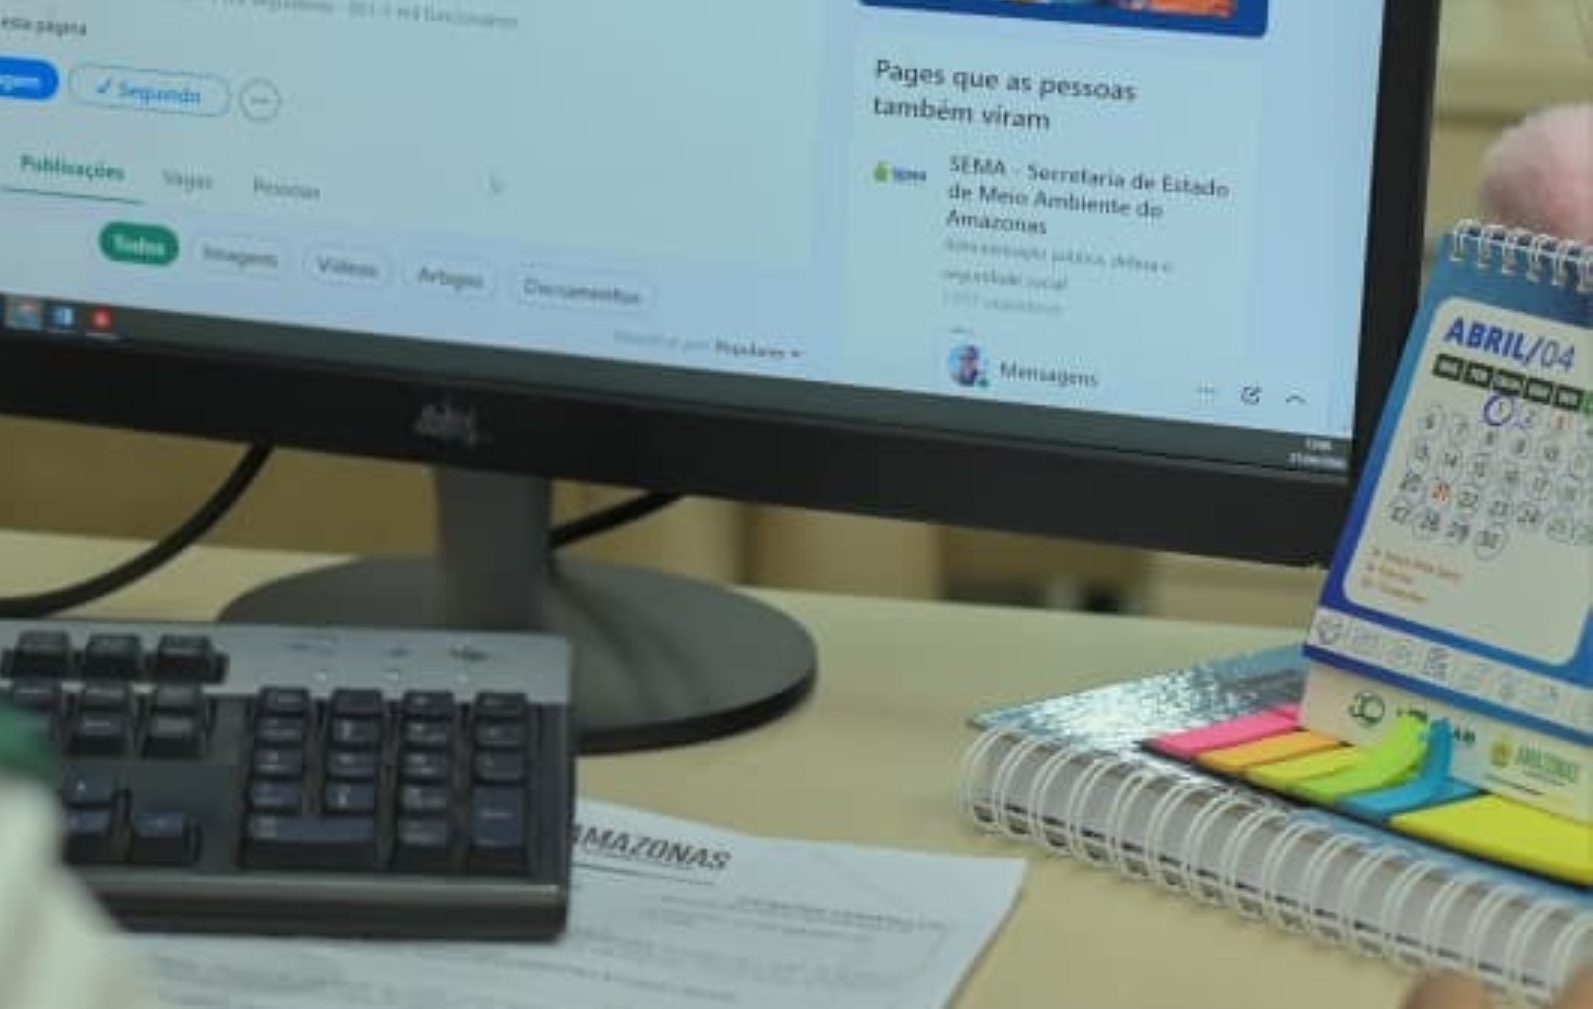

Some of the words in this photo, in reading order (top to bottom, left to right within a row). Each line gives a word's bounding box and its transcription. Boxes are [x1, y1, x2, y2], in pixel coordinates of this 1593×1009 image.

[118, 80, 202, 107] Seguindo
[876, 58, 945, 87] Pages
[952, 68, 999, 94] que
[1007, 73, 1032, 92] as
[1038, 75, 1138, 102] pessoas
[873, 95, 974, 124] também
[981, 104, 1051, 131] viram
[20, 153, 126, 184] Publicações
[948, 154, 1007, 177] SEMA
[1026, 160, 1126, 189] Secretaria
[1130, 172, 1156, 191] de
[1161, 174, 1231, 199] Estado
[947, 183, 973, 201] de
[978, 184, 1029, 206] Meio
[1032, 190, 1131, 217] Ambiente
[1135, 200, 1165, 220] do
[945, 208, 1048, 236] Amazonas
[1443, 317, 1576, 372] ABRIL/04
[999, 359, 1099, 389] Mensagens
